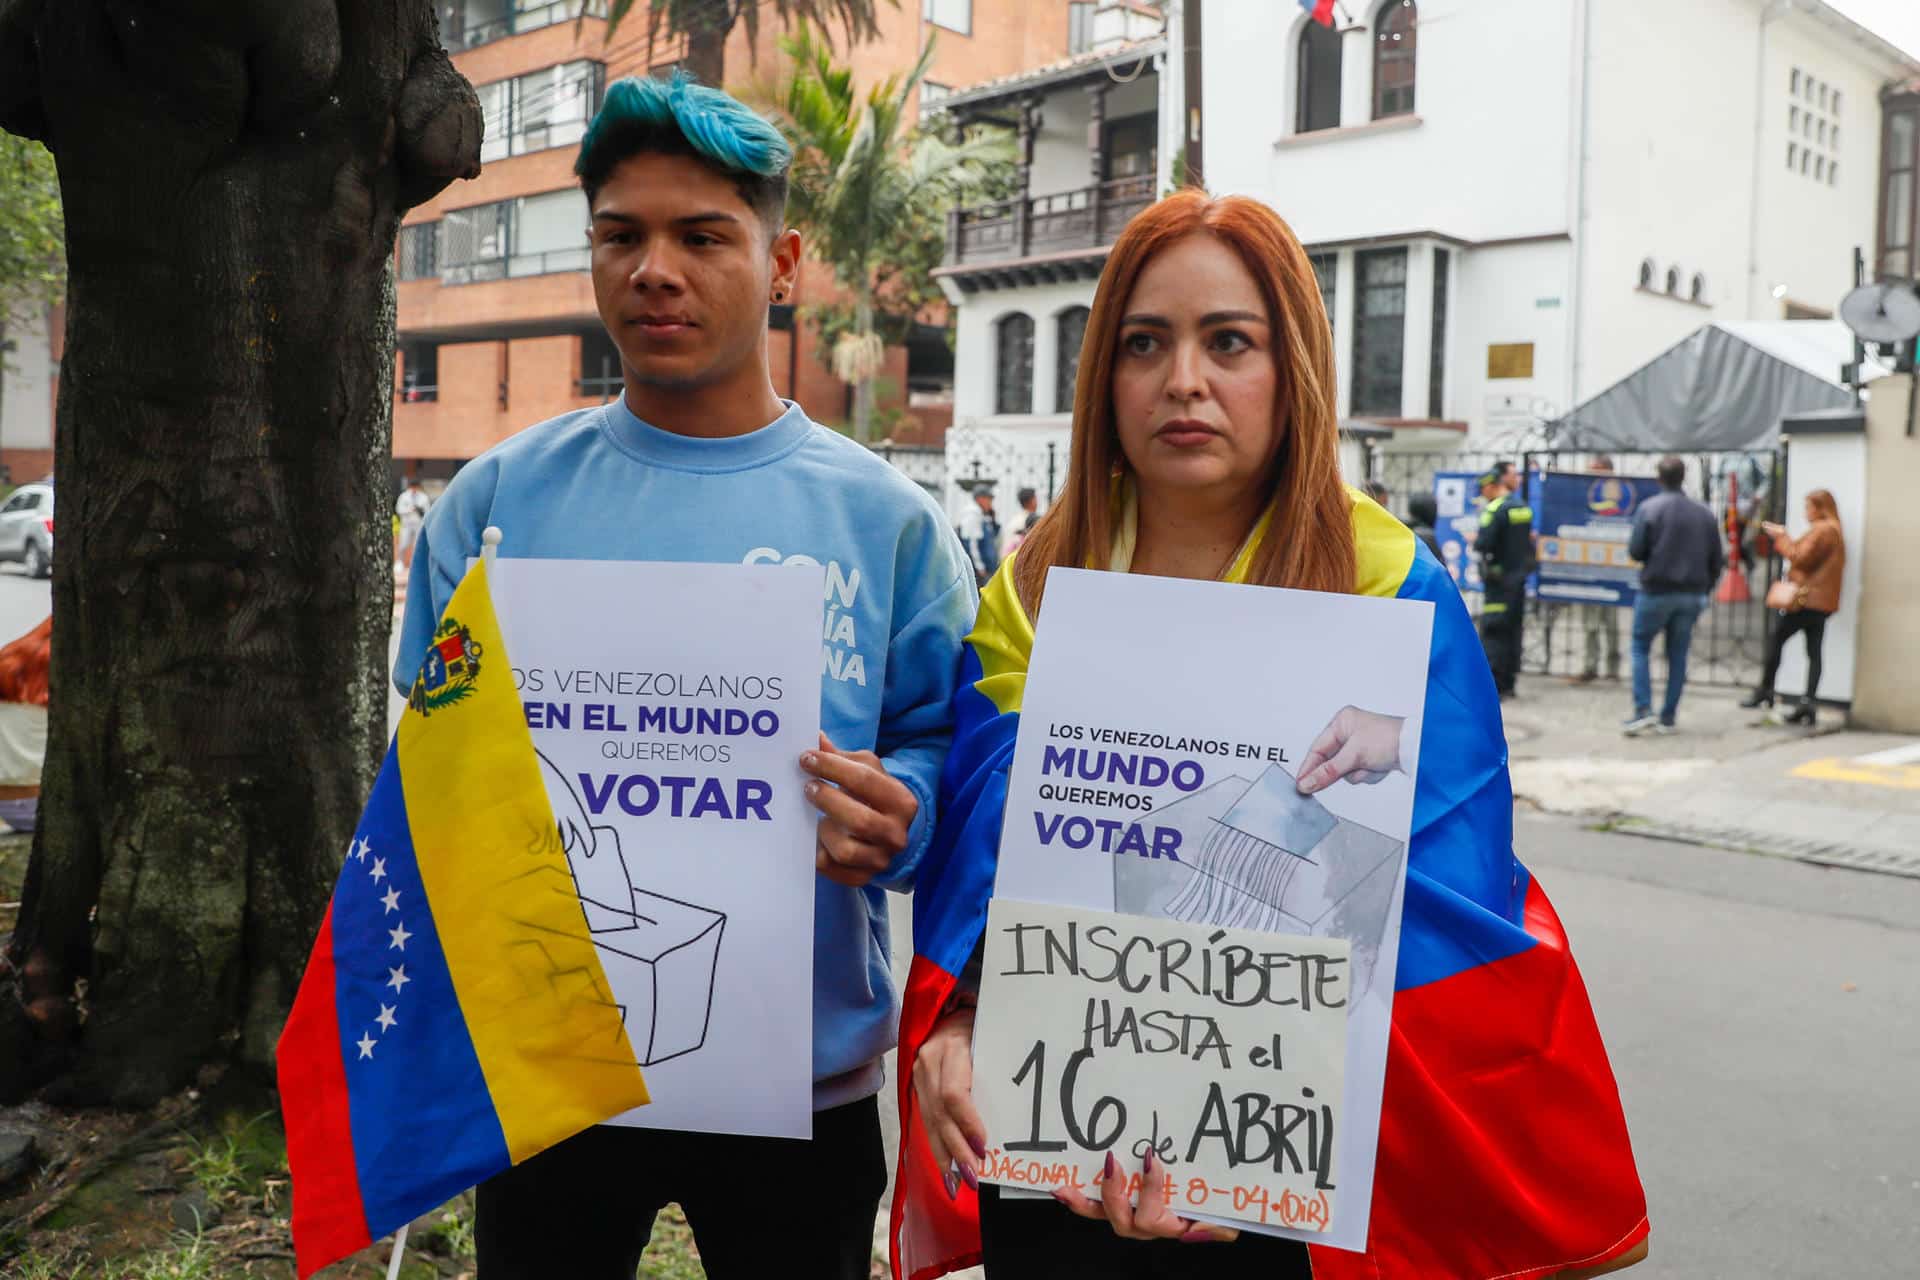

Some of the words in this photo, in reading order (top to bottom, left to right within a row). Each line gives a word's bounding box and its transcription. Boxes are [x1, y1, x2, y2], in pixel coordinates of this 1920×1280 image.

[511, 667, 544, 692] OS
[554, 669, 783, 700] VENEZOLANOS
[523, 702, 571, 730] EN
[583, 704, 627, 732] EL
[638, 706, 780, 737] MUNDO
[1049, 723, 1084, 740] LOS
[1089, 728, 1230, 758] VENEZOLANOS
[1235, 743, 1262, 760] EN
[1267, 746, 1289, 763] EL
[601, 740, 731, 763] QUEREMOS
[1041, 745, 1205, 792] MUNDO
[578, 773, 773, 821] VOTAR
[1038, 784, 1153, 812] QUEREMOS
[1033, 811, 1183, 862] VOTAR
[1000, 921, 1347, 1011] INSCRÍBETE
[1083, 998, 1231, 1069] HASTA
[1248, 1034, 1283, 1070] el
[1003, 1040, 1127, 1152] 16
[1132, 1110, 1178, 1165] de
